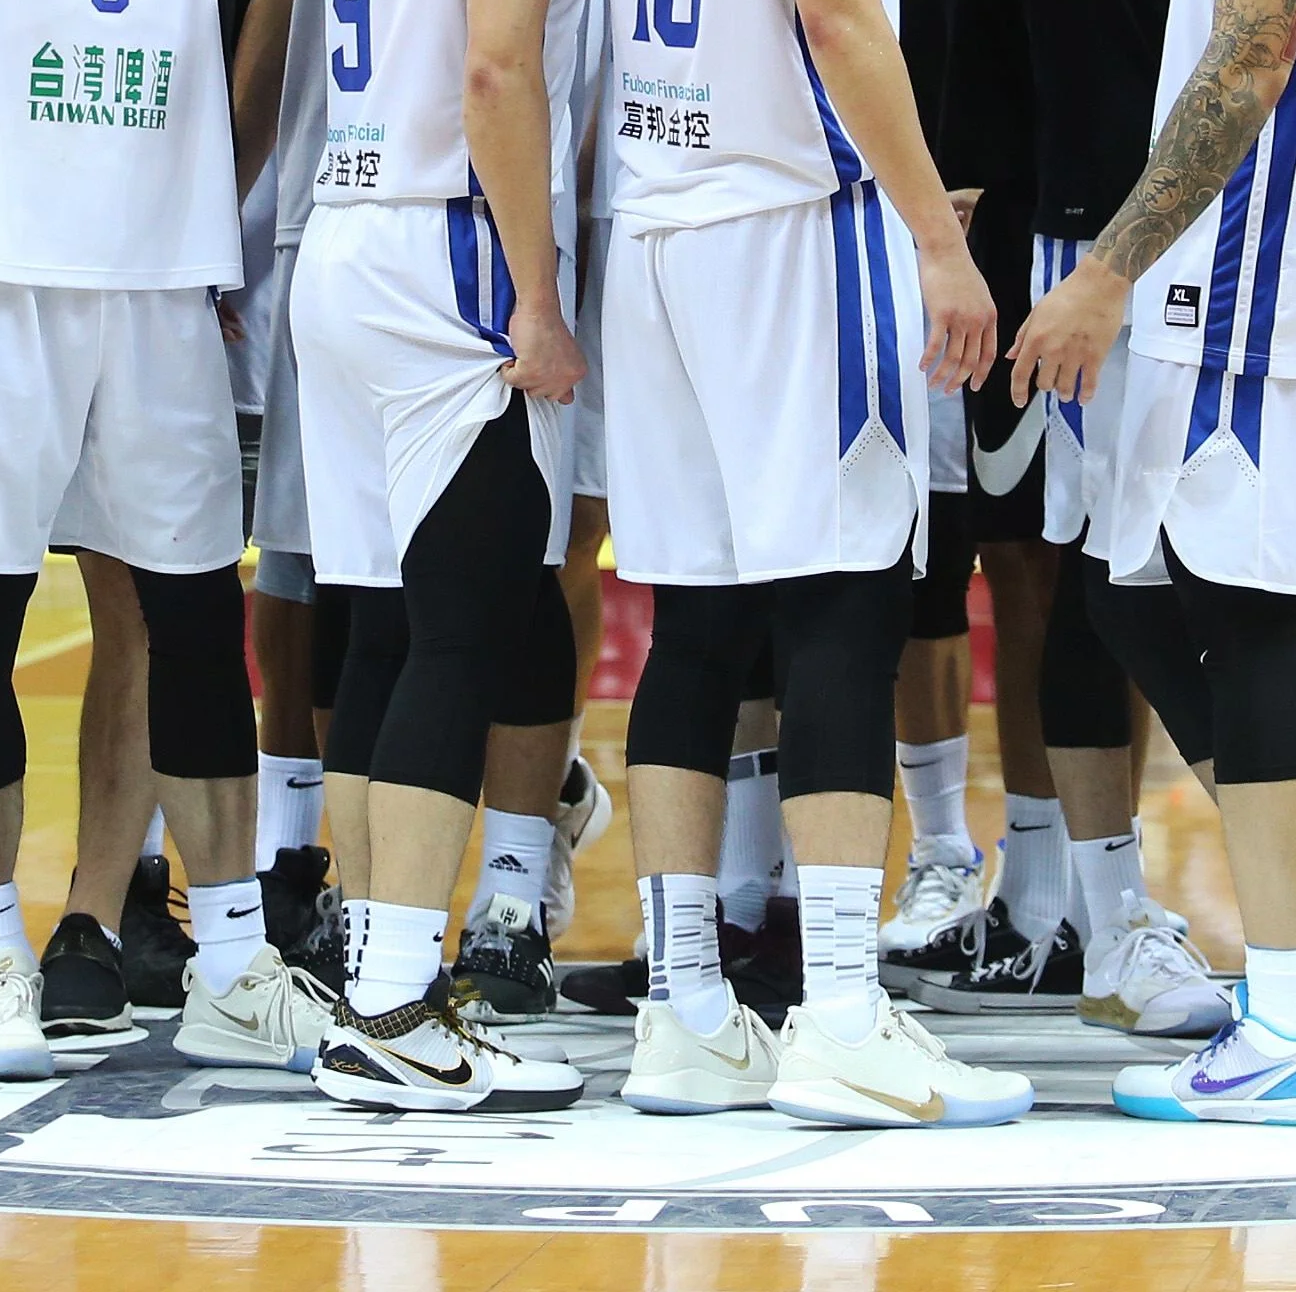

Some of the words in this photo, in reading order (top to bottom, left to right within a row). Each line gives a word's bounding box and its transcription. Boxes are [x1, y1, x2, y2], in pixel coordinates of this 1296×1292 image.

[622, 72, 656, 96] Fubon
[27, 99, 115, 126] TAIWAN
[123, 106, 167, 131] BEER
[618, 100, 711, 150] 富邦金控
[1172, 288, 1190, 302] XL
[520, 1197, 1167, 1223] CUP
